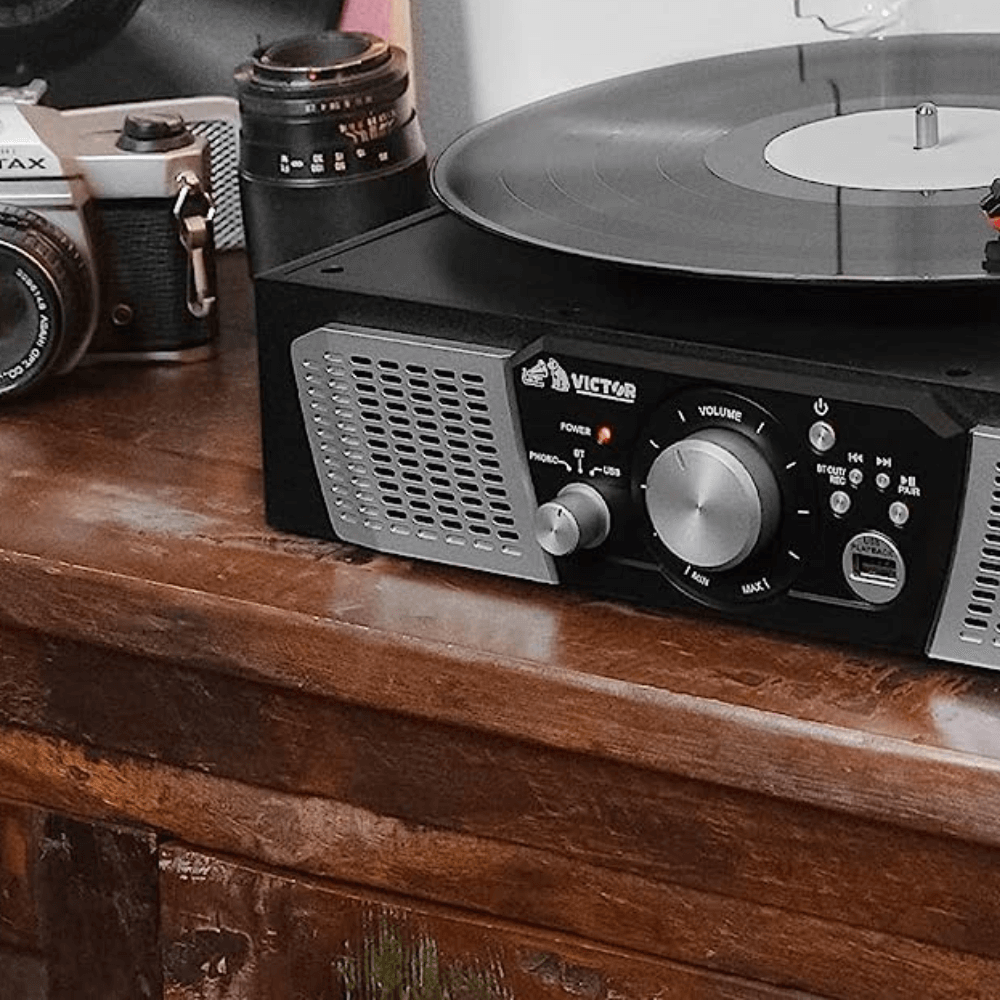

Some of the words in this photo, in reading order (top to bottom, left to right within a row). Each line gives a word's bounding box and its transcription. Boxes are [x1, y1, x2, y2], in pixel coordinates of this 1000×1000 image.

[0, 157, 46, 170] TAX
[571, 373, 636, 399] VICTOR
[697, 405, 743, 423] VOLUME
[559, 421, 592, 436] POWER
[529, 450, 560, 465] PHONO
[897, 484, 921, 497] PAIR
[691, 570, 710, 587] MIN
[741, 581, 765, 595] MAX
